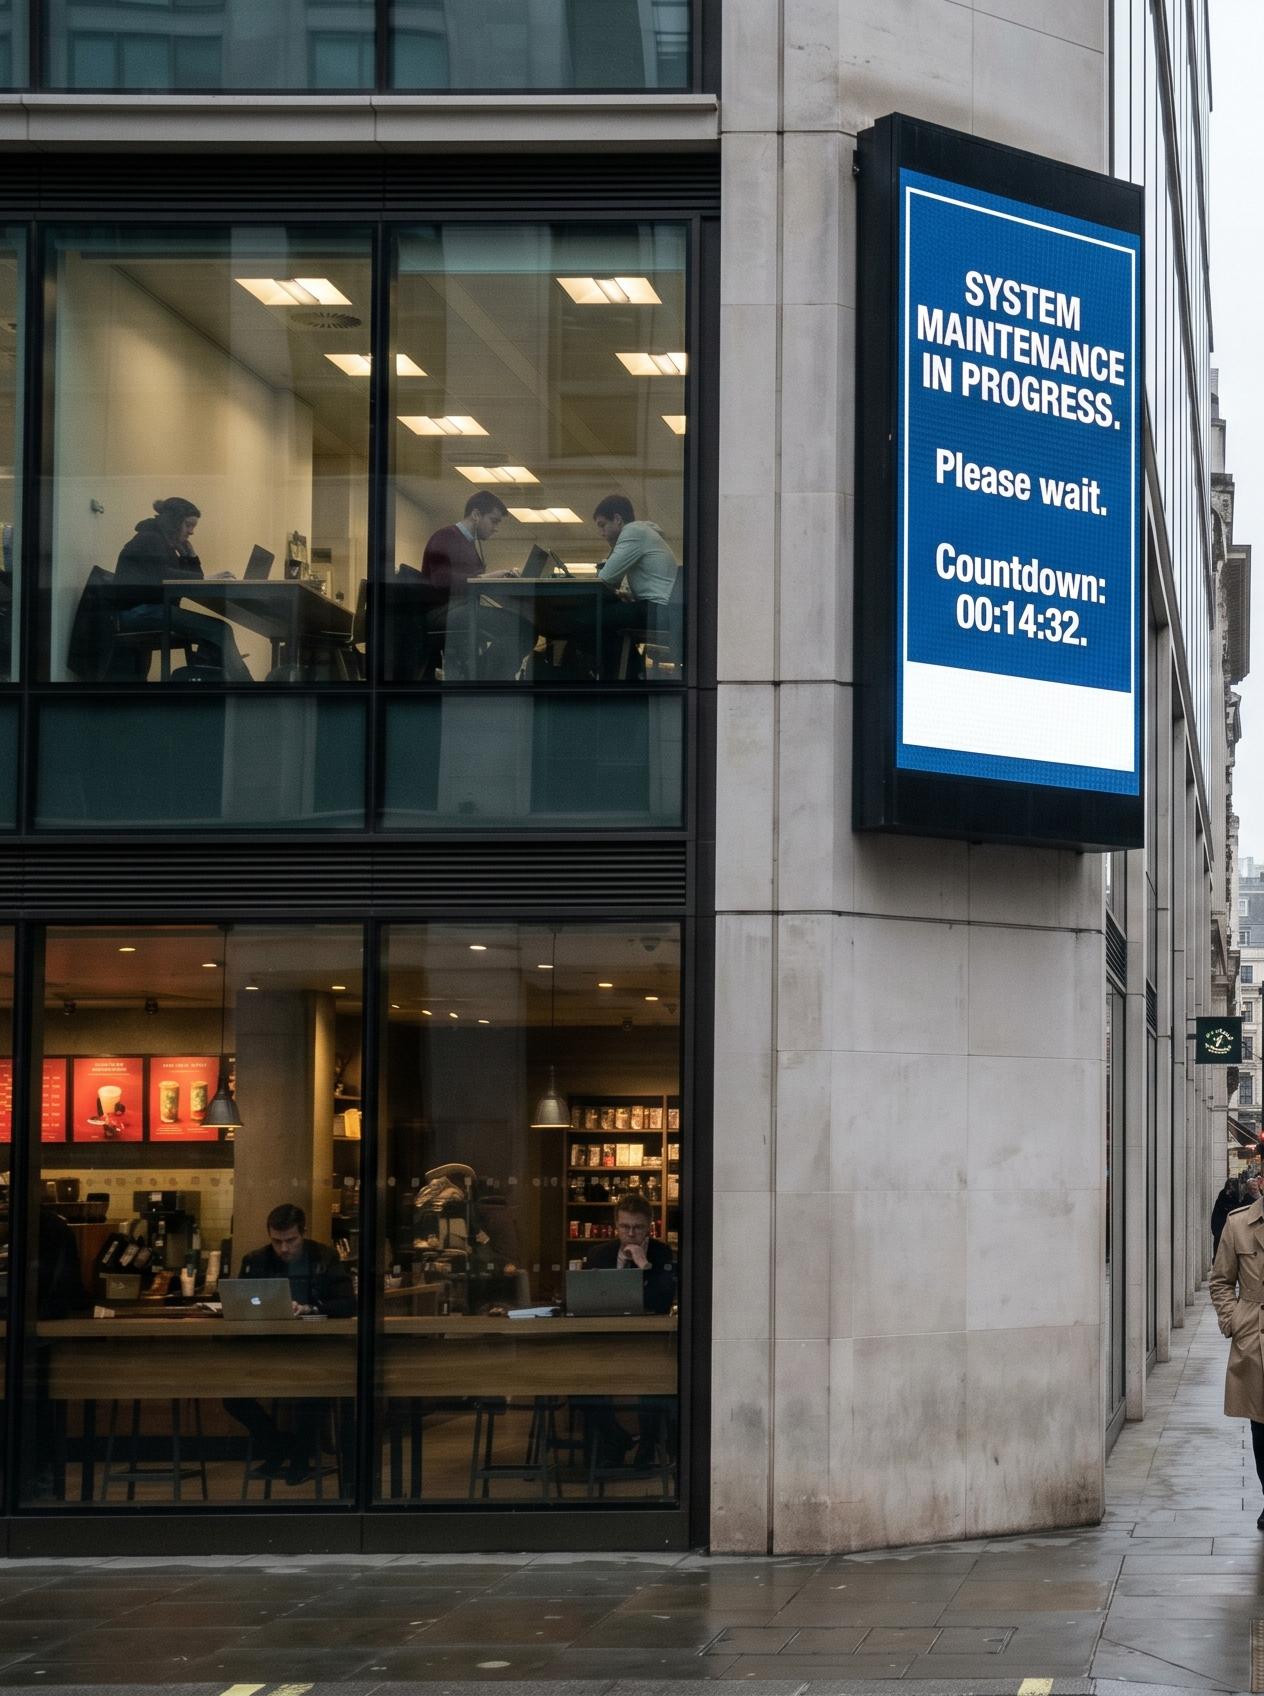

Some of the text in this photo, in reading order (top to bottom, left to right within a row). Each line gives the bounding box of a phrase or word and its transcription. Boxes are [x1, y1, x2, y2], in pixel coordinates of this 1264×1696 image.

[965, 270, 1081, 332] SYSTEM
[917, 304, 1125, 386] MAINTENANCE
[923, 352, 1121, 430] IN PROGRESS.
[936, 448, 1107, 516] Please wait.
[936, 542, 1106, 604] Countdown:
[956, 593, 1088, 647] 00:14:32.
